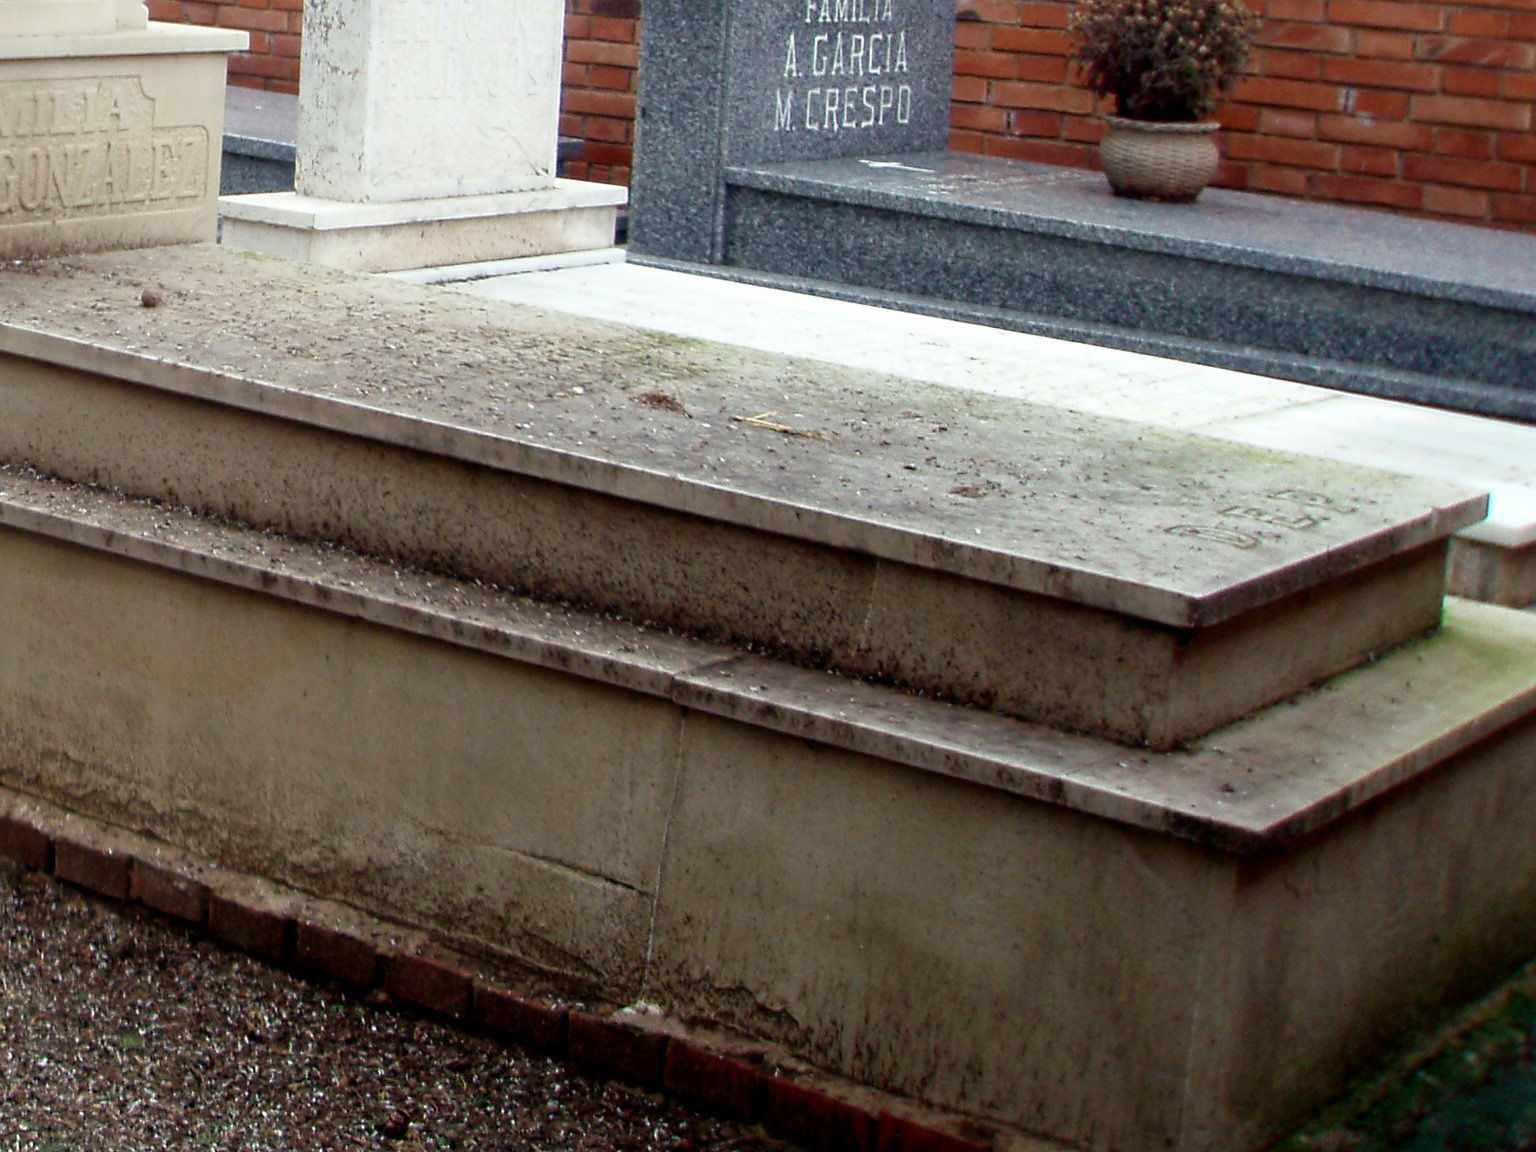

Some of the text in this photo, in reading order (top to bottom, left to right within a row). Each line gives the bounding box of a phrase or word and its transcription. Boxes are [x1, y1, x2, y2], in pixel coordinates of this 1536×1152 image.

[783, 29, 909, 78] A. GARCIA
[773, 84, 912, 132] M. CRESPO
